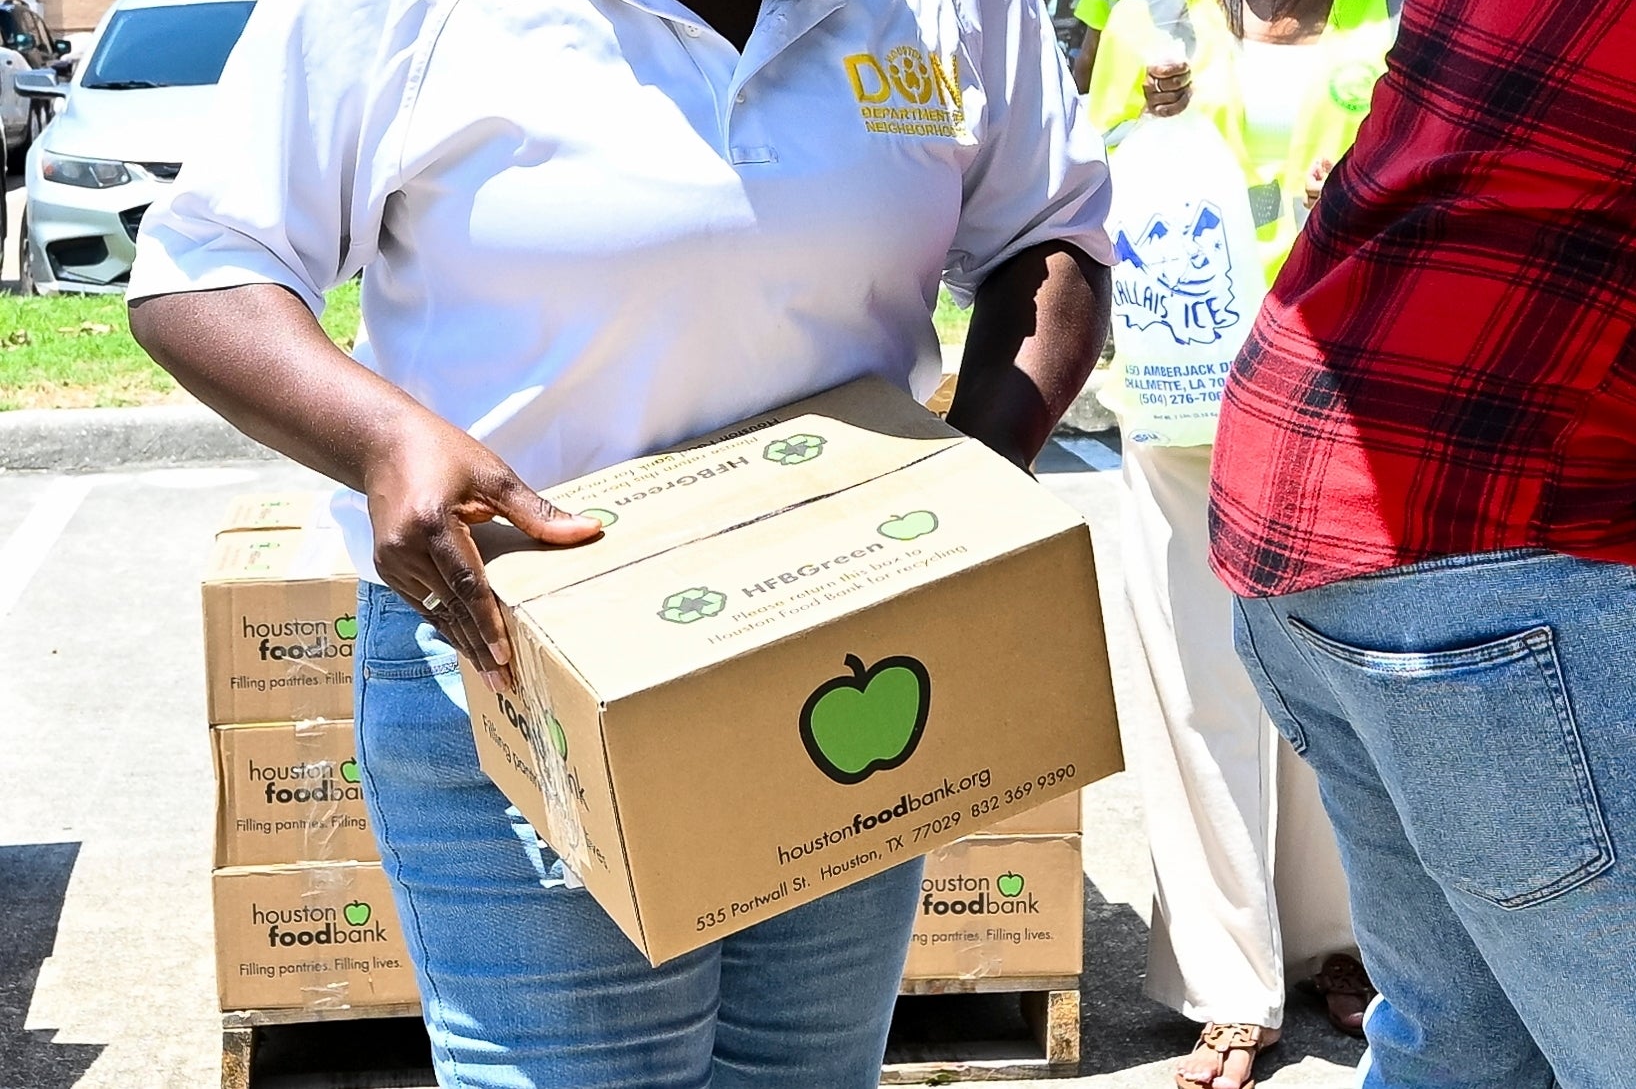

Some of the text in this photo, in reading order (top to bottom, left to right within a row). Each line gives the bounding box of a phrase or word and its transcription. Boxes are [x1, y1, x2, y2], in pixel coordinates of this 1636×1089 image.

[861, 106, 950, 123] DEPARTMENT
[865, 120, 966, 138] NEIGHBORHO
[1184, 296, 1227, 328] ICE
[1143, 363, 1217, 378] AMBERJACK
[1188, 379, 1206, 390] LA
[1139, 391, 1222, 407] (504) 276-70
[614, 456, 750, 506] HFBGreen
[741, 542, 884, 598] HFBGreen
[707, 543, 968, 646] Houston Food Bank for recycling
[731, 547, 922, 623] Please return this box to
[243, 615, 328, 639] houston
[258, 638, 352, 661] foodba
[230, 676, 266, 692] Filling
[325, 672, 352, 685] Fillin
[249, 760, 333, 781] houston
[264, 780, 363, 804] foodba
[237, 819, 271, 834] Filling
[331, 815, 367, 829] Filling
[777, 767, 992, 866] houstonfoodbank.org
[695, 764, 1077, 931] 535 Portwall St. Houston, TX 77029 832 369 9390
[921, 874, 990, 892] ouston
[252, 903, 336, 925] houston
[922, 892, 1040, 916] foodbank
[268, 920, 387, 947] foodbank
[931, 929, 983, 945] pantries.
[986, 928, 1021, 944] Filling
[1024, 927, 1054, 941] lives.
[239, 956, 403, 977] Filling pantries. Filling lives.
